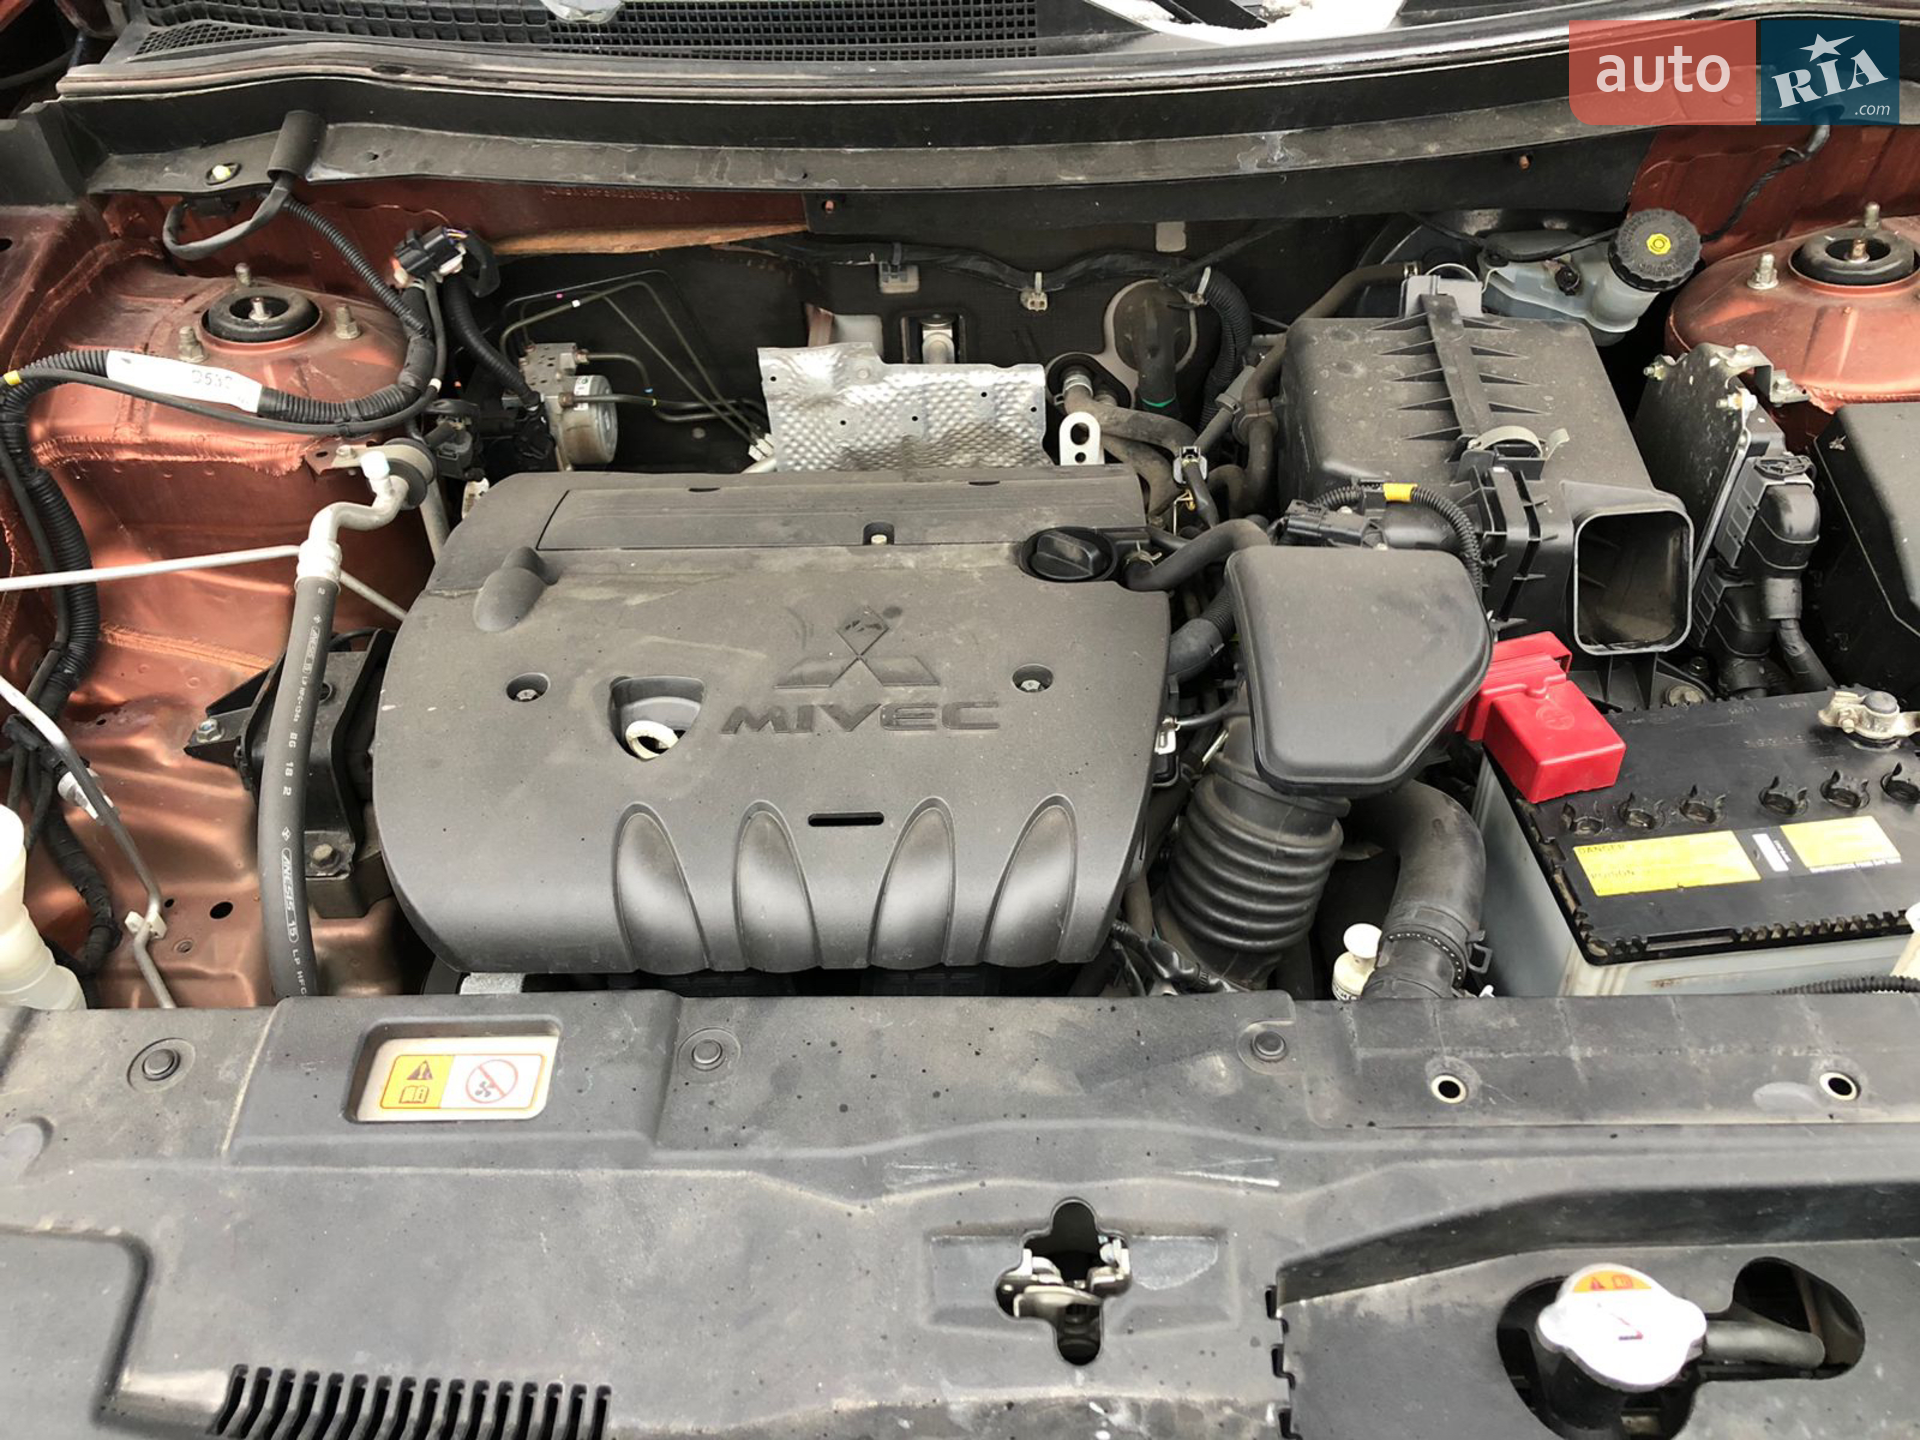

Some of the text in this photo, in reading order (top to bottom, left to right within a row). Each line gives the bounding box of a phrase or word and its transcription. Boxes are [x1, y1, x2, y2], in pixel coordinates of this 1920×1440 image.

[720, 701, 1000, 735] MIVEC
[282, 785, 293, 797] 2
[292, 949, 301, 965] LP
